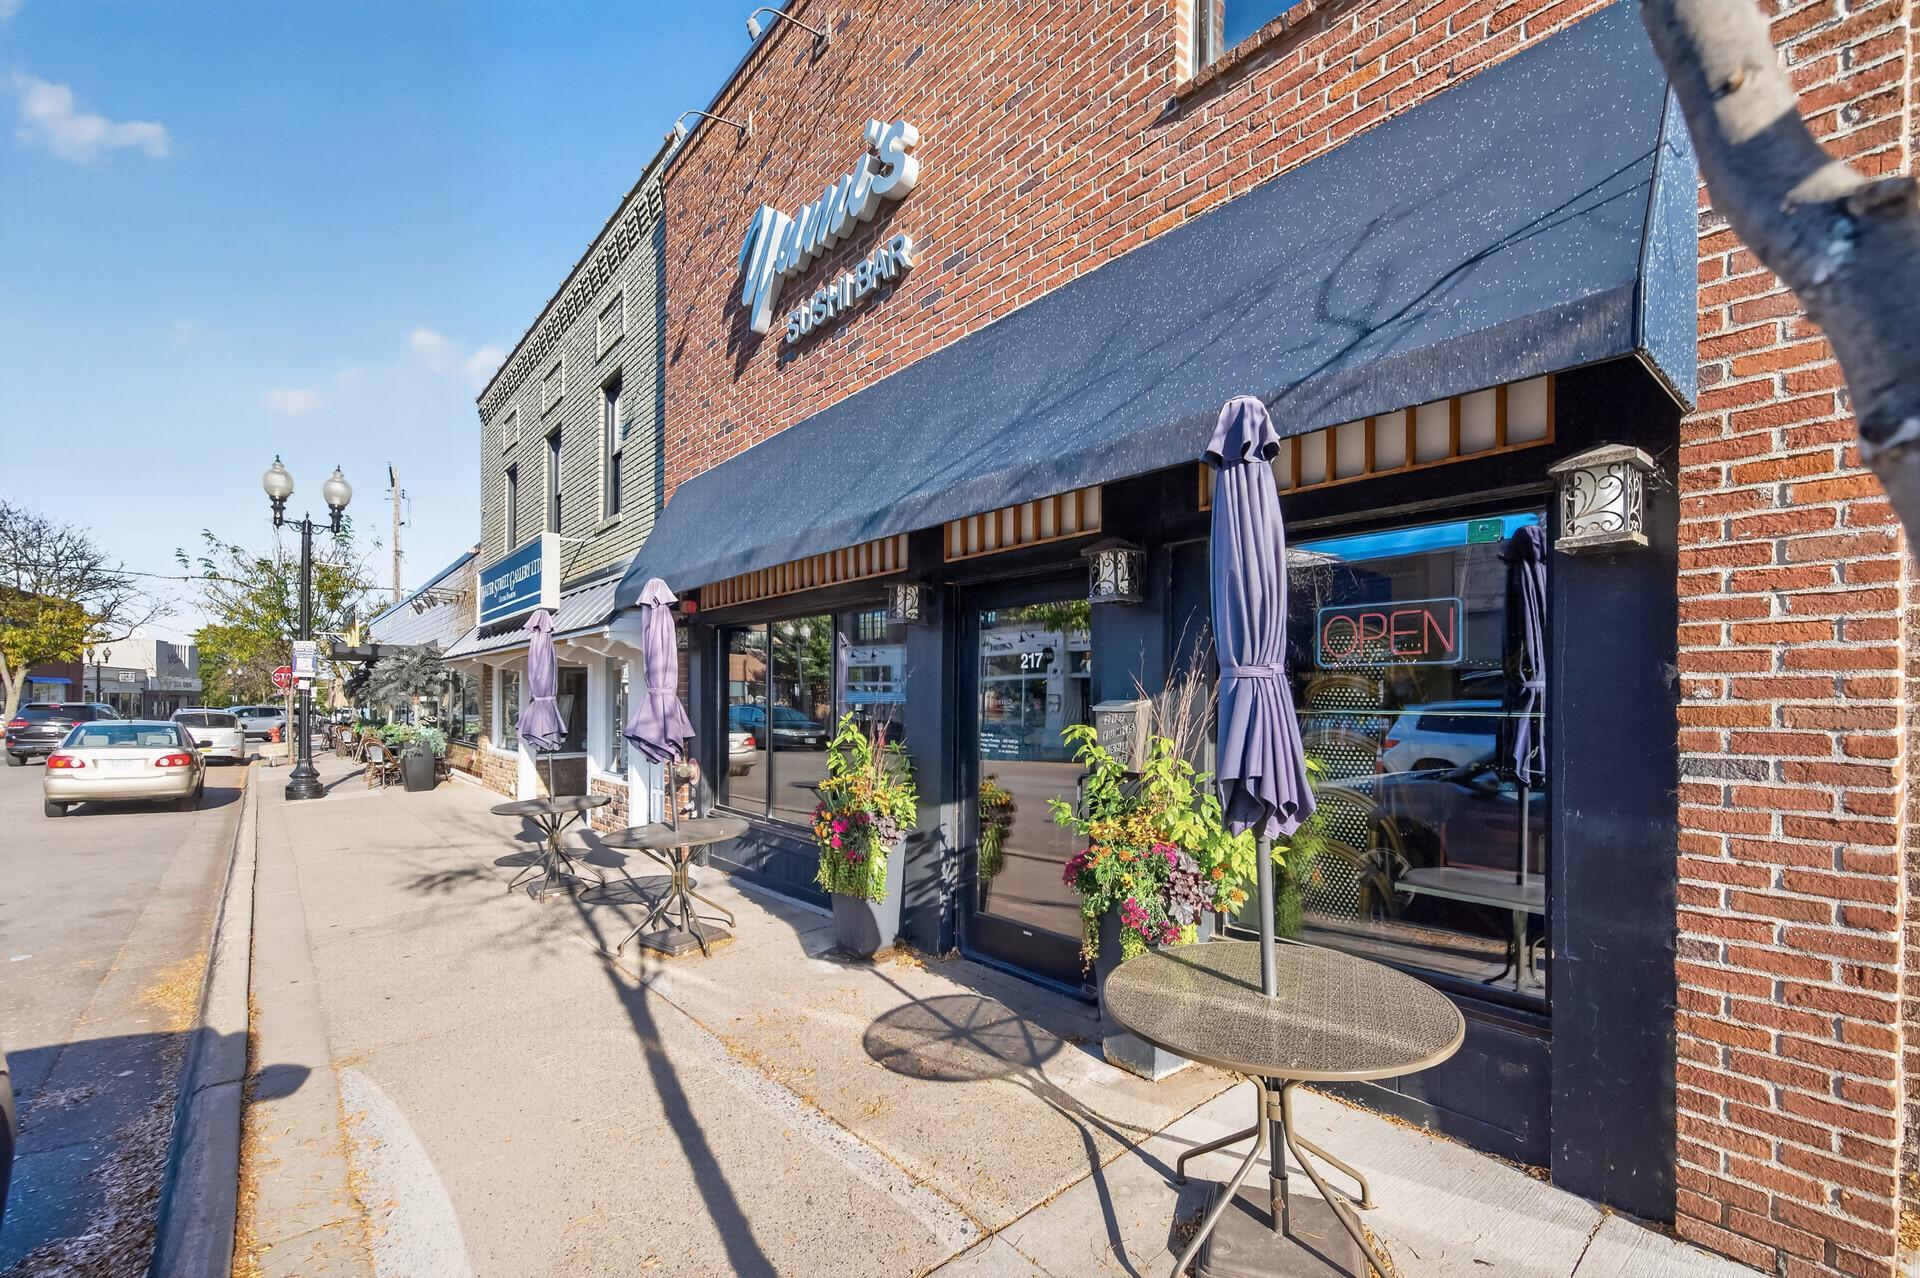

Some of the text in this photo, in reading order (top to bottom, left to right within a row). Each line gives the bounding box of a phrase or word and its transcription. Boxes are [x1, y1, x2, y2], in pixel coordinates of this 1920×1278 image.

[786, 232, 913, 345] SUSHI BAR
[1323, 607, 1454, 658] OPEN
[273, 672, 293, 683] STO
[1020, 652, 1043, 669] 217
